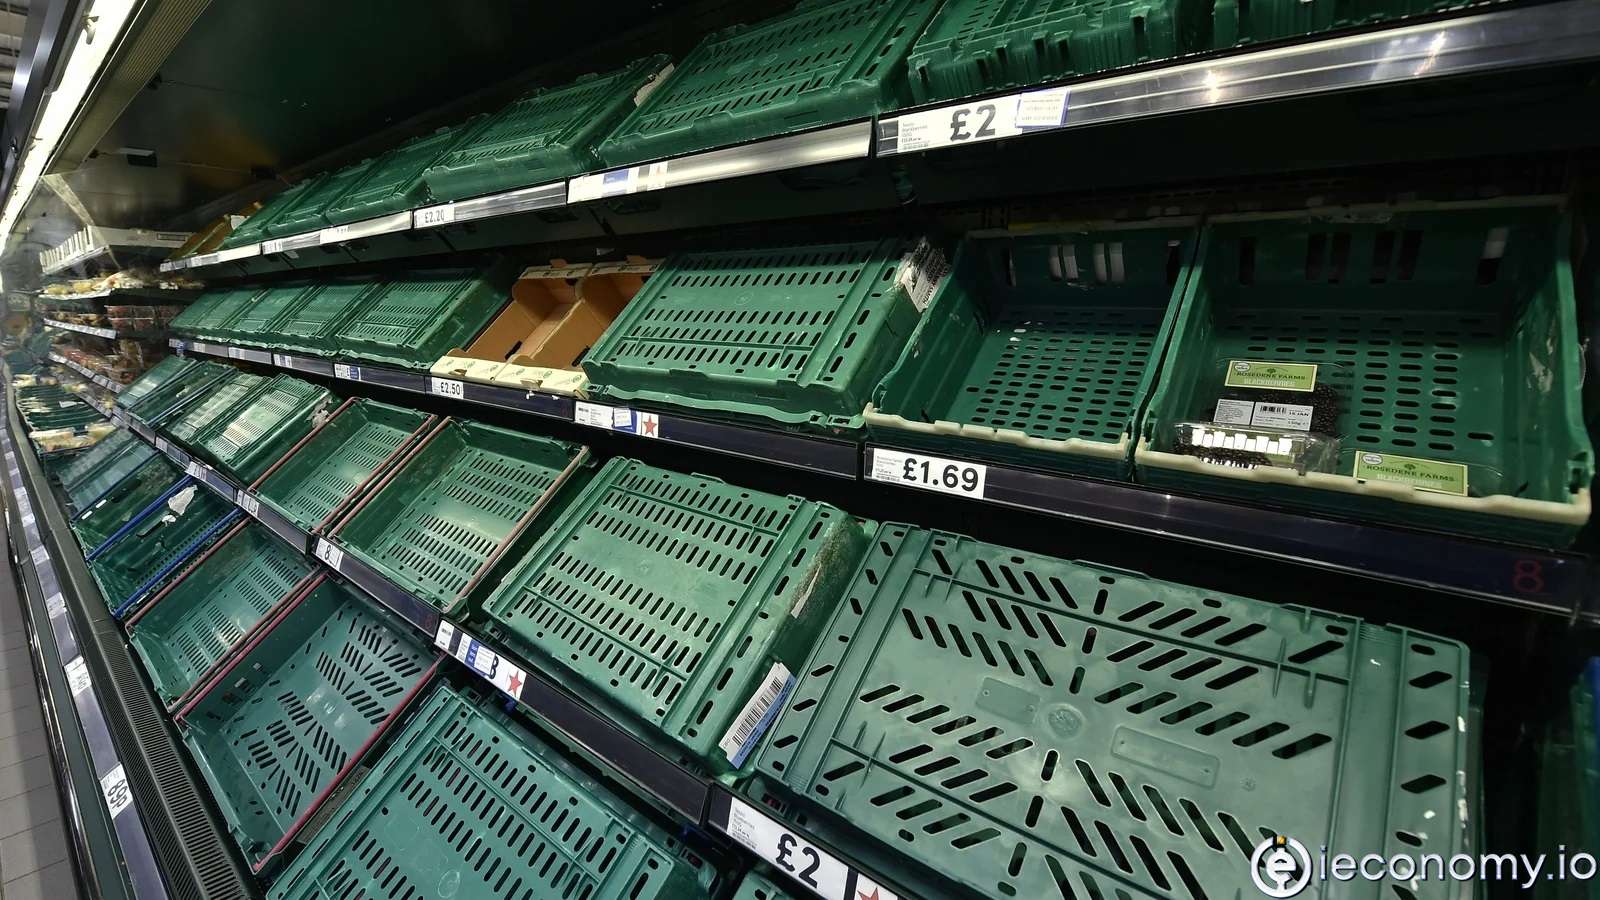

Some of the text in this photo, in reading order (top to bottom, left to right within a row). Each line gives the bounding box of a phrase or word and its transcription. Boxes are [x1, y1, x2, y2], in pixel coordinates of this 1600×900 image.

[950, 104, 997, 142] £2
[424, 209, 445, 224] £2.20
[440, 381, 461, 396] £2.50
[1236, 370, 1277, 379] ROSEDENE
[902, 457, 979, 492] £1.69
[1366, 464, 1456, 482] ROSEDENE FARMS
[1512, 559, 1545, 593] 8
[108, 778, 128, 809] 89p
[775, 833, 821, 889] £2
